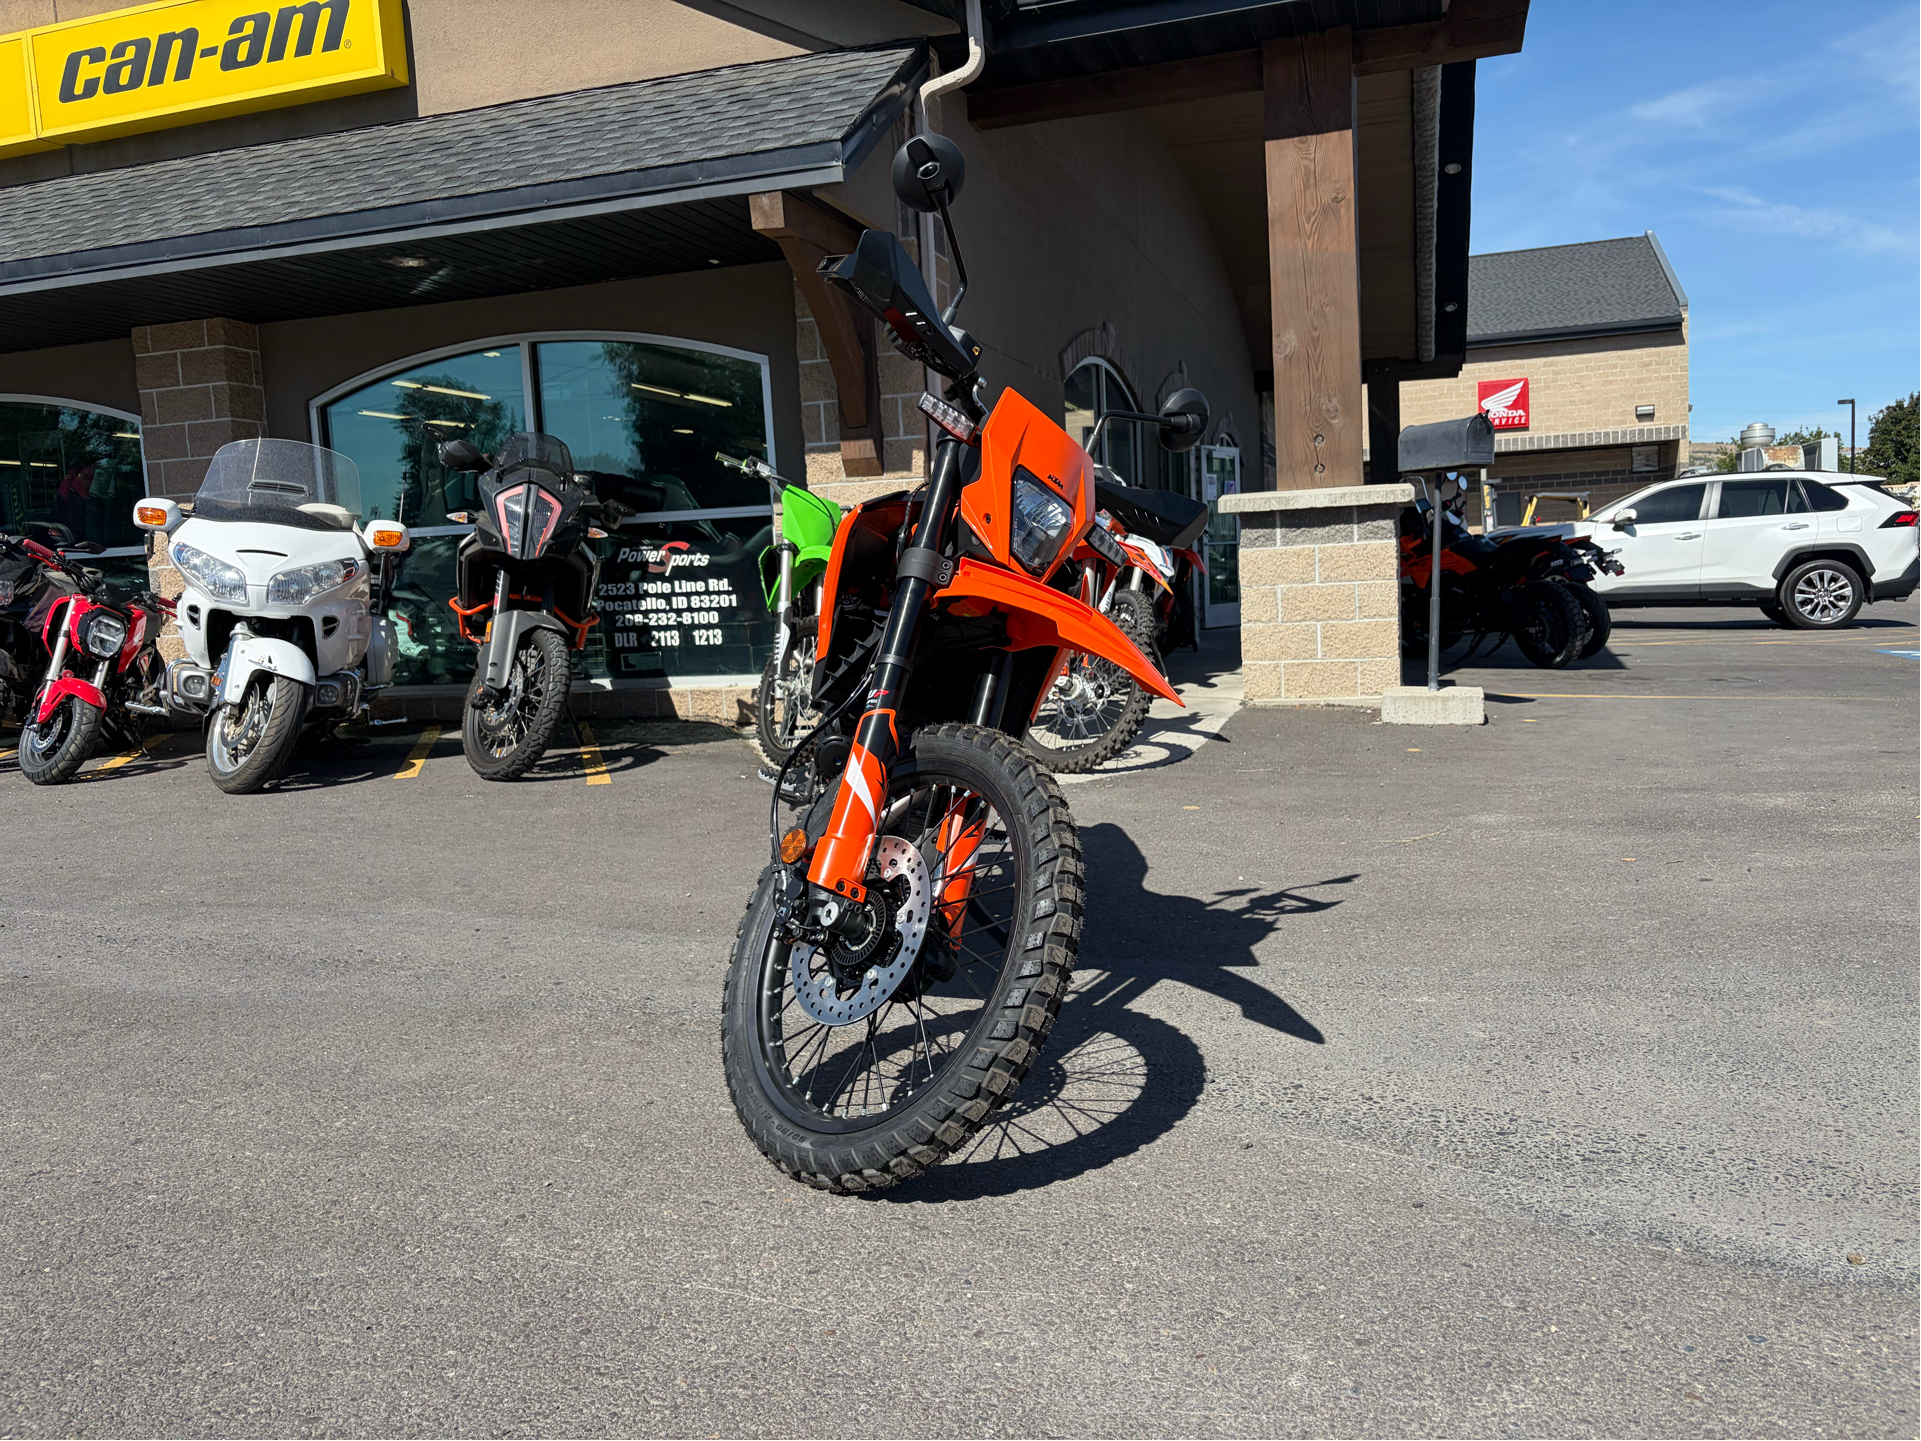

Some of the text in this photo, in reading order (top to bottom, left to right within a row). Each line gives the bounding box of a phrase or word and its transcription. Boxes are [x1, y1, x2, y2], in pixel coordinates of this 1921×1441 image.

[59, 0, 350, 103] can-am
[1488, 410, 1526, 418] ONDA
[1047, 474, 1064, 490] KTM
[599, 578, 733, 596] 2523 Pole Line Rd.
[596, 594, 737, 611] Pocatello, ID 83201
[615, 611, 719, 627] 208-232-8100
[614, 629, 723, 648] DLR 2113 1213
